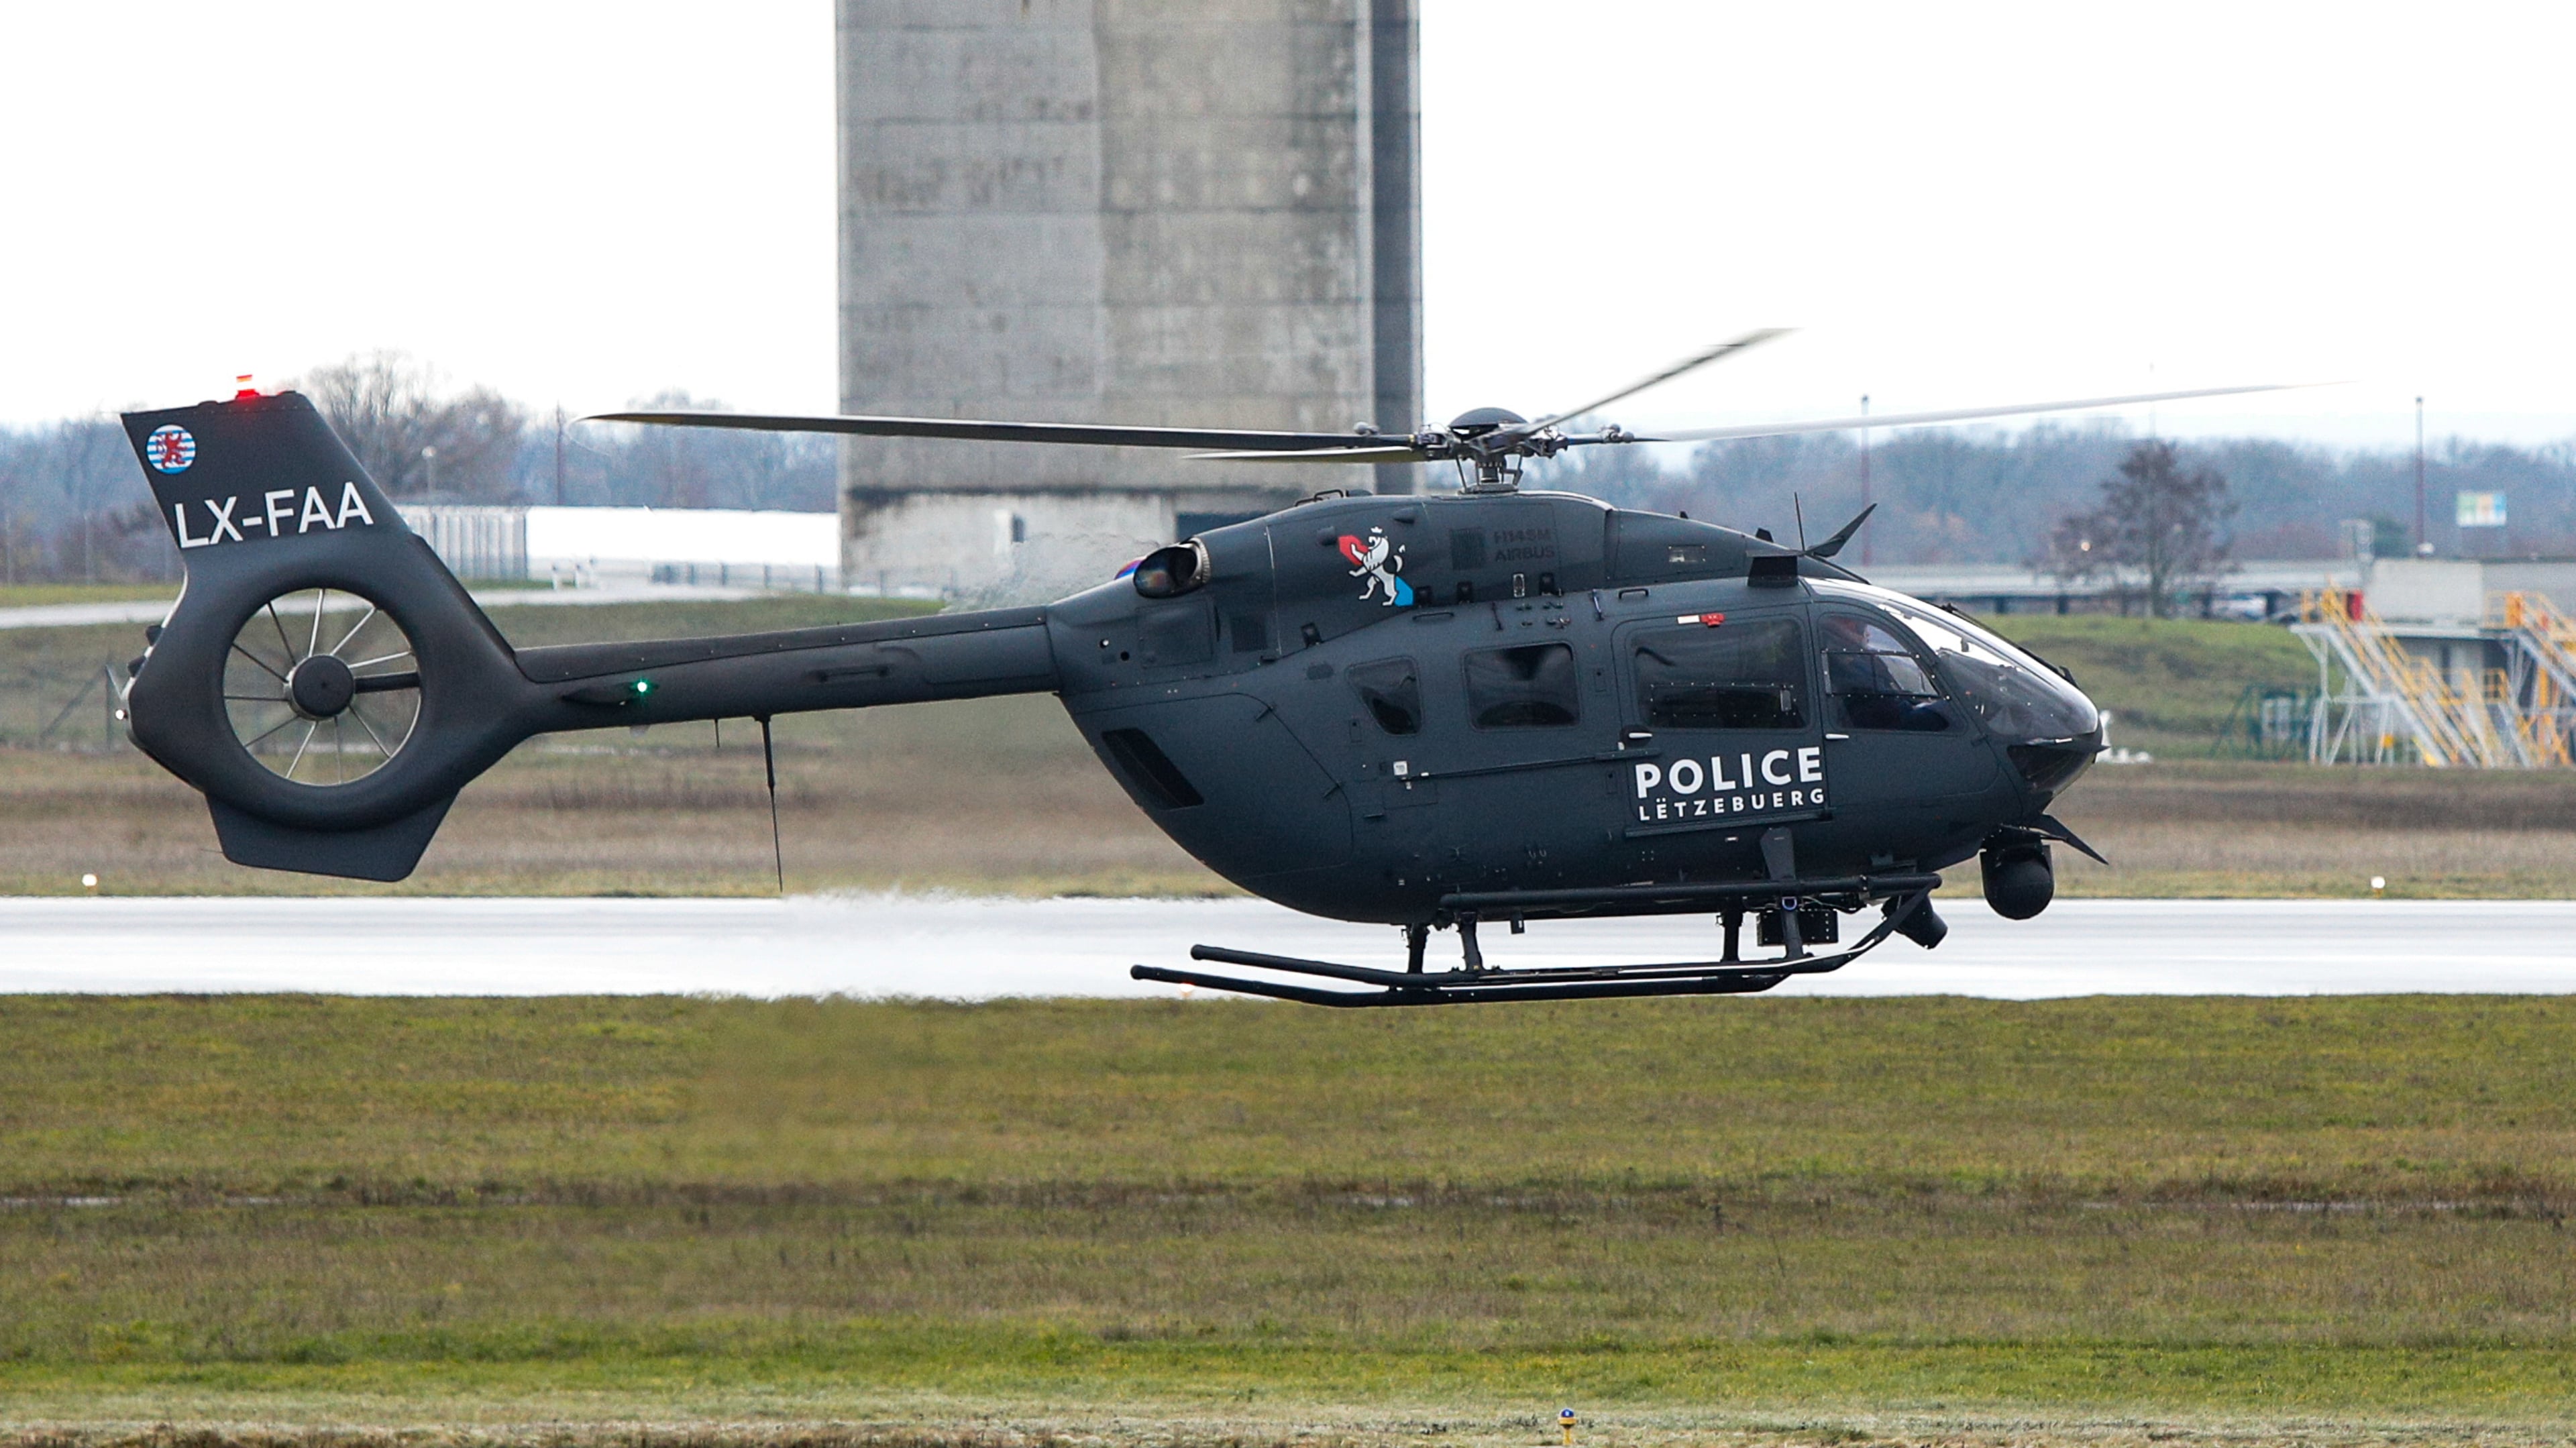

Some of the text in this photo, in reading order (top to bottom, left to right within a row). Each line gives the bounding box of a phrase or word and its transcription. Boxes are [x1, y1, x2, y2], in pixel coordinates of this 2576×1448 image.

[175, 481, 374, 549] LX-FAA
[1495, 545, 1555, 562] AIRBUS
[1635, 746, 1823, 799] POLICE
[1639, 788, 1824, 821] LËTZEBUERG
